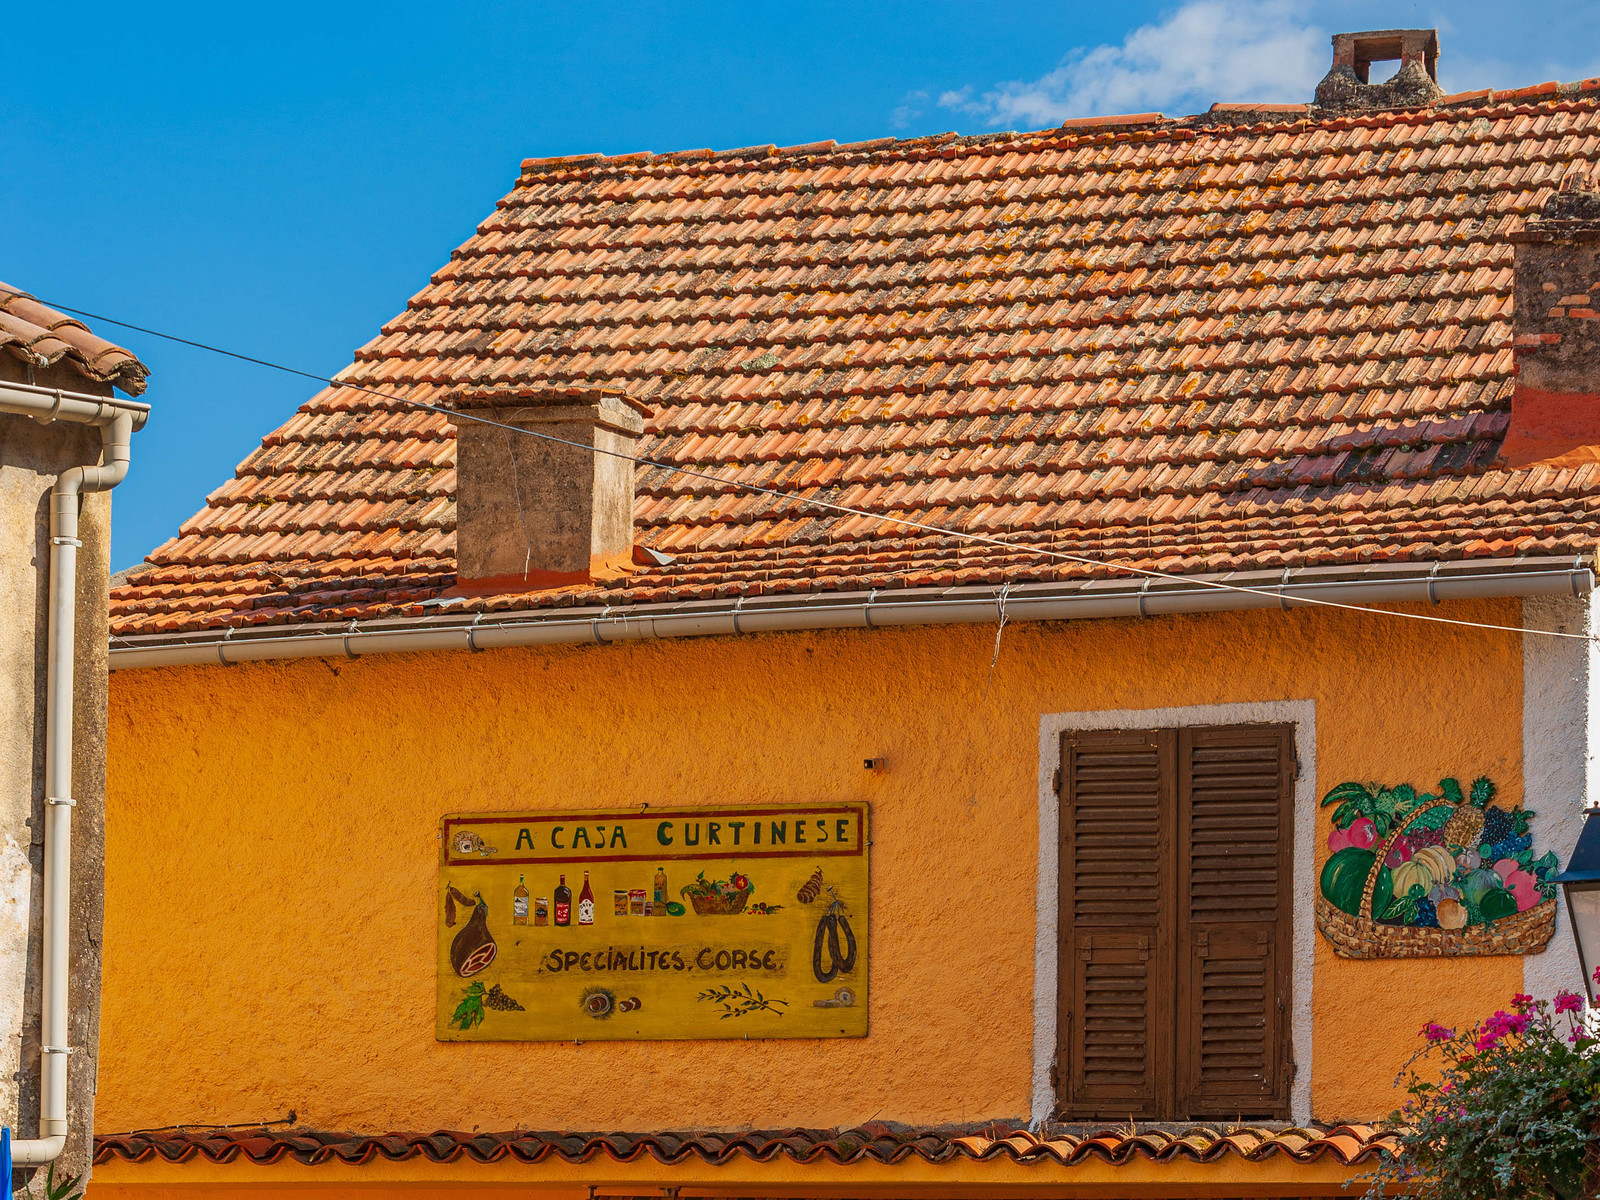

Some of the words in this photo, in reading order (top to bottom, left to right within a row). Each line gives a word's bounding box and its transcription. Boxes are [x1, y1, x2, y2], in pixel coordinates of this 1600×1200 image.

[514, 828, 535, 851] A
[550, 824, 628, 850] CASA
[656, 819, 850, 847] CURTINESE
